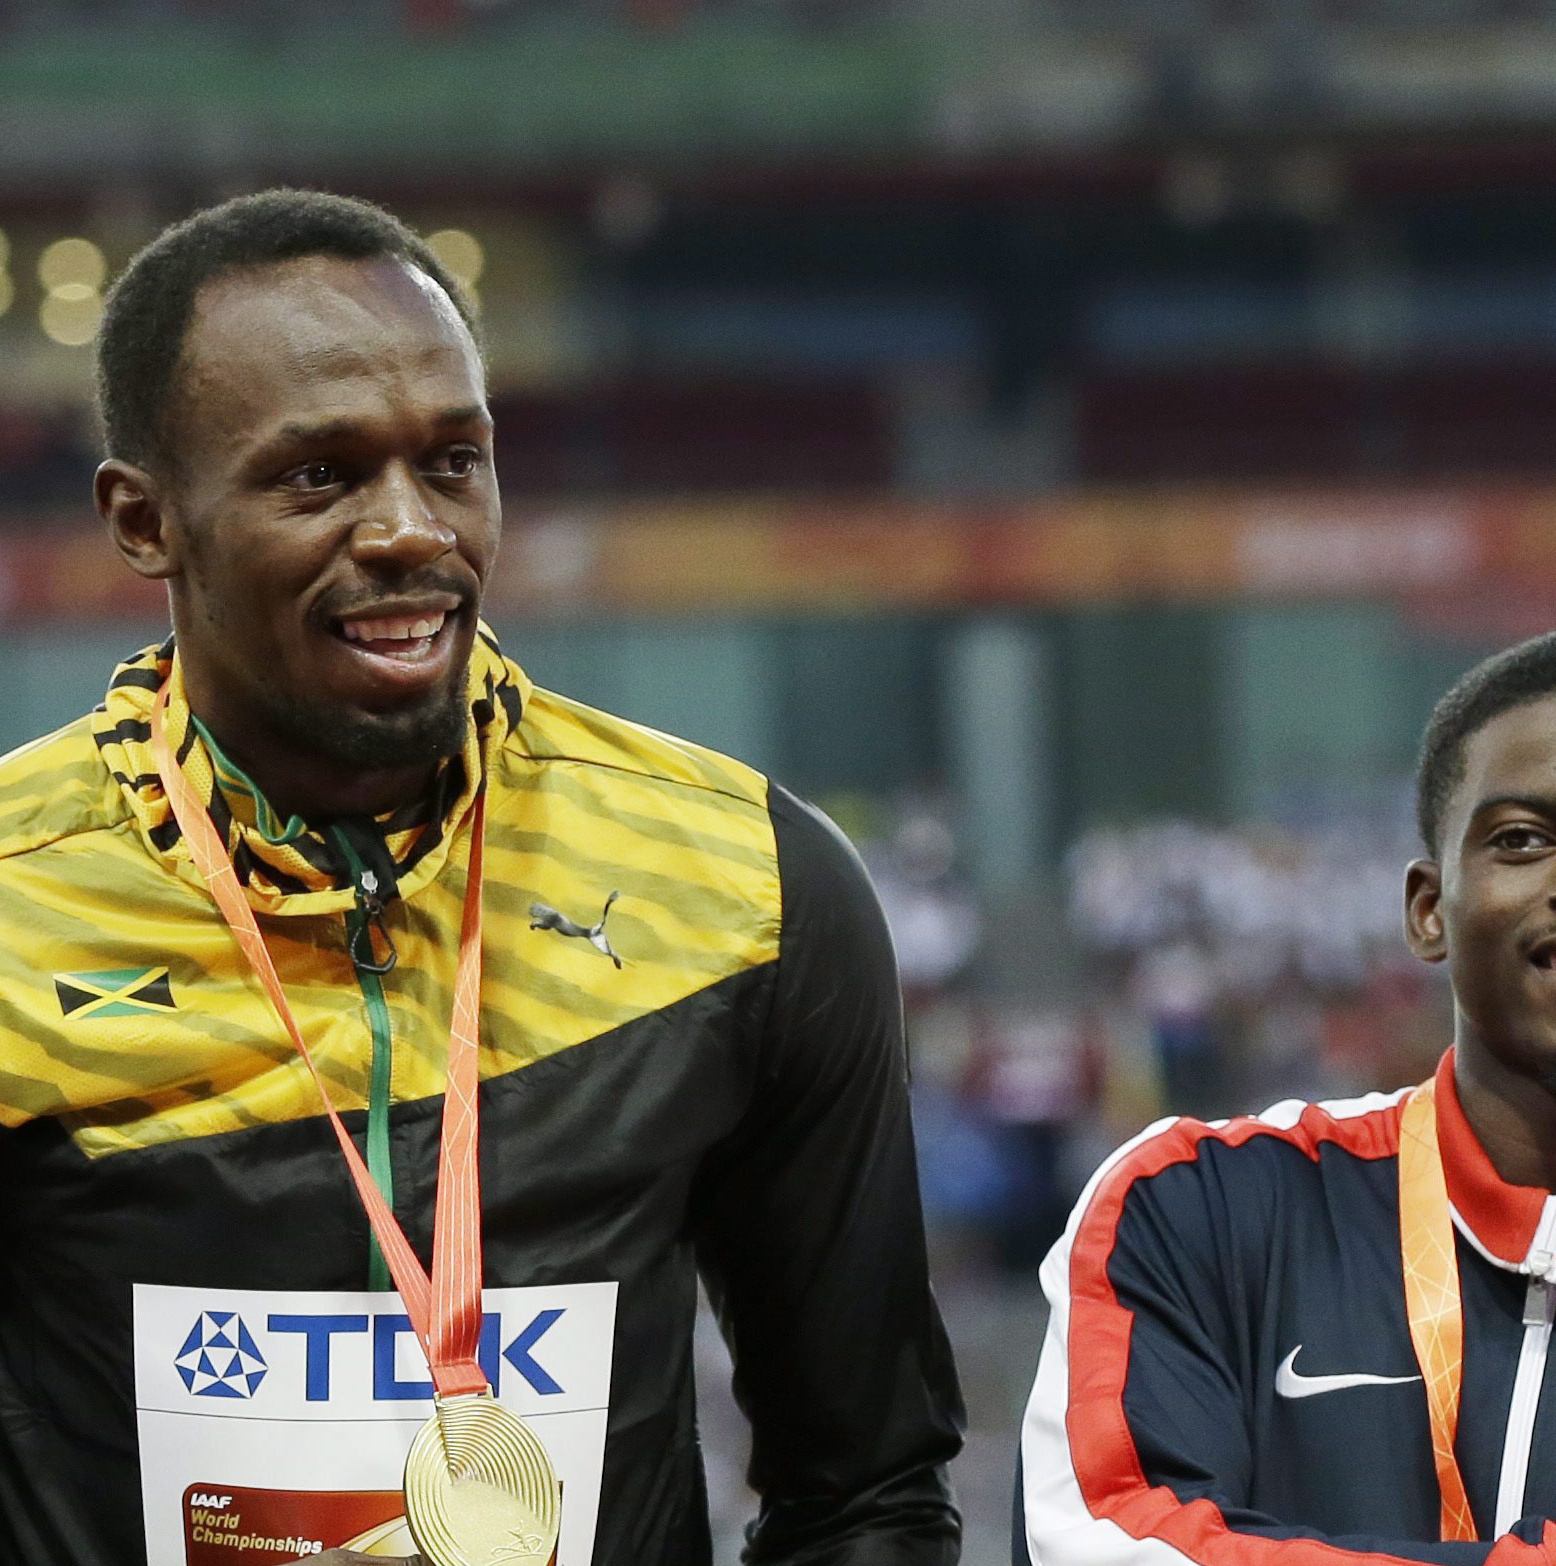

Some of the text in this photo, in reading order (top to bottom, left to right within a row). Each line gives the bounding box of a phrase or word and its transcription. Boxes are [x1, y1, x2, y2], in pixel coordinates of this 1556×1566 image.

[190, 1493, 232, 1509] IAAF
[191, 1509, 240, 1529] World
[193, 1527, 323, 1556] Championships
